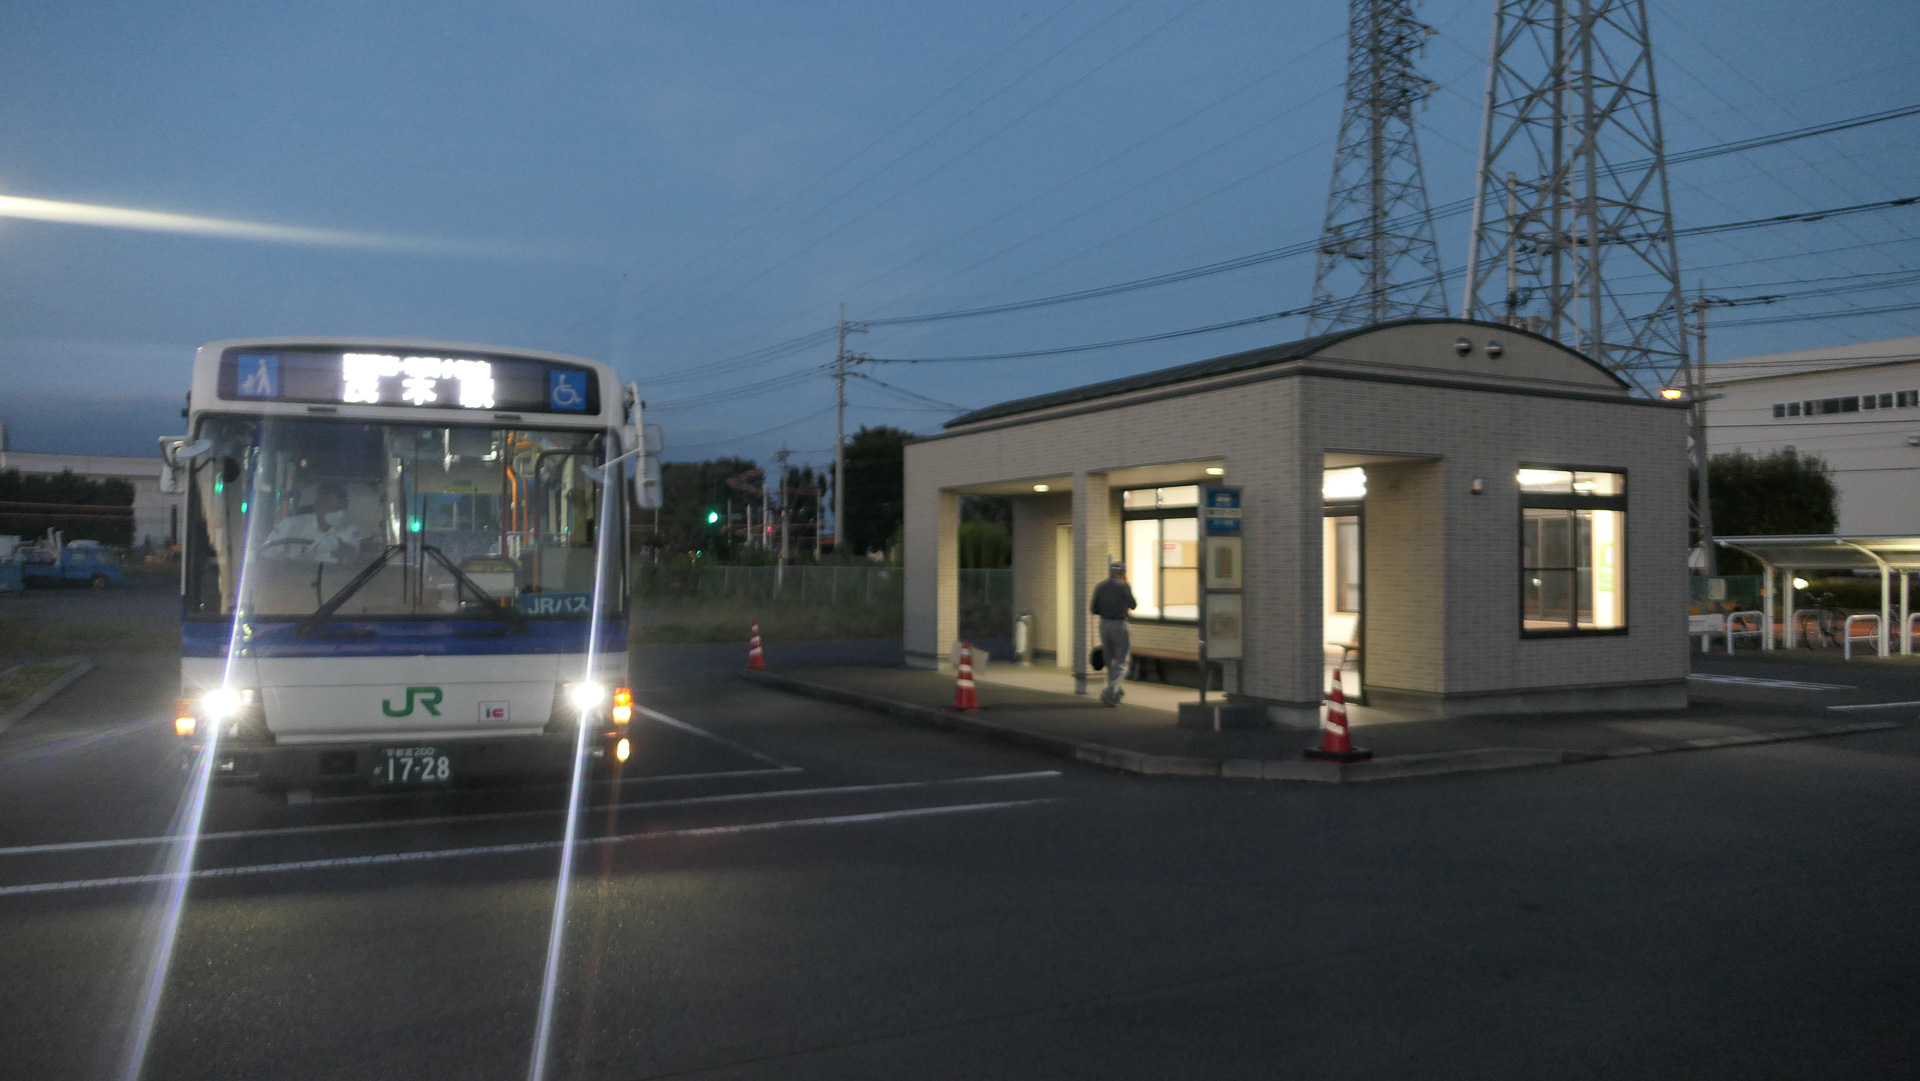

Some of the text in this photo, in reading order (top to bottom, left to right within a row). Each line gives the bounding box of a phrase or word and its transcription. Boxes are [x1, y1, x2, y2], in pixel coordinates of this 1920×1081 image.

[527, 596, 590, 614] JRバス
[382, 686, 443, 717] JR
[387, 755, 450, 783] 17-28
